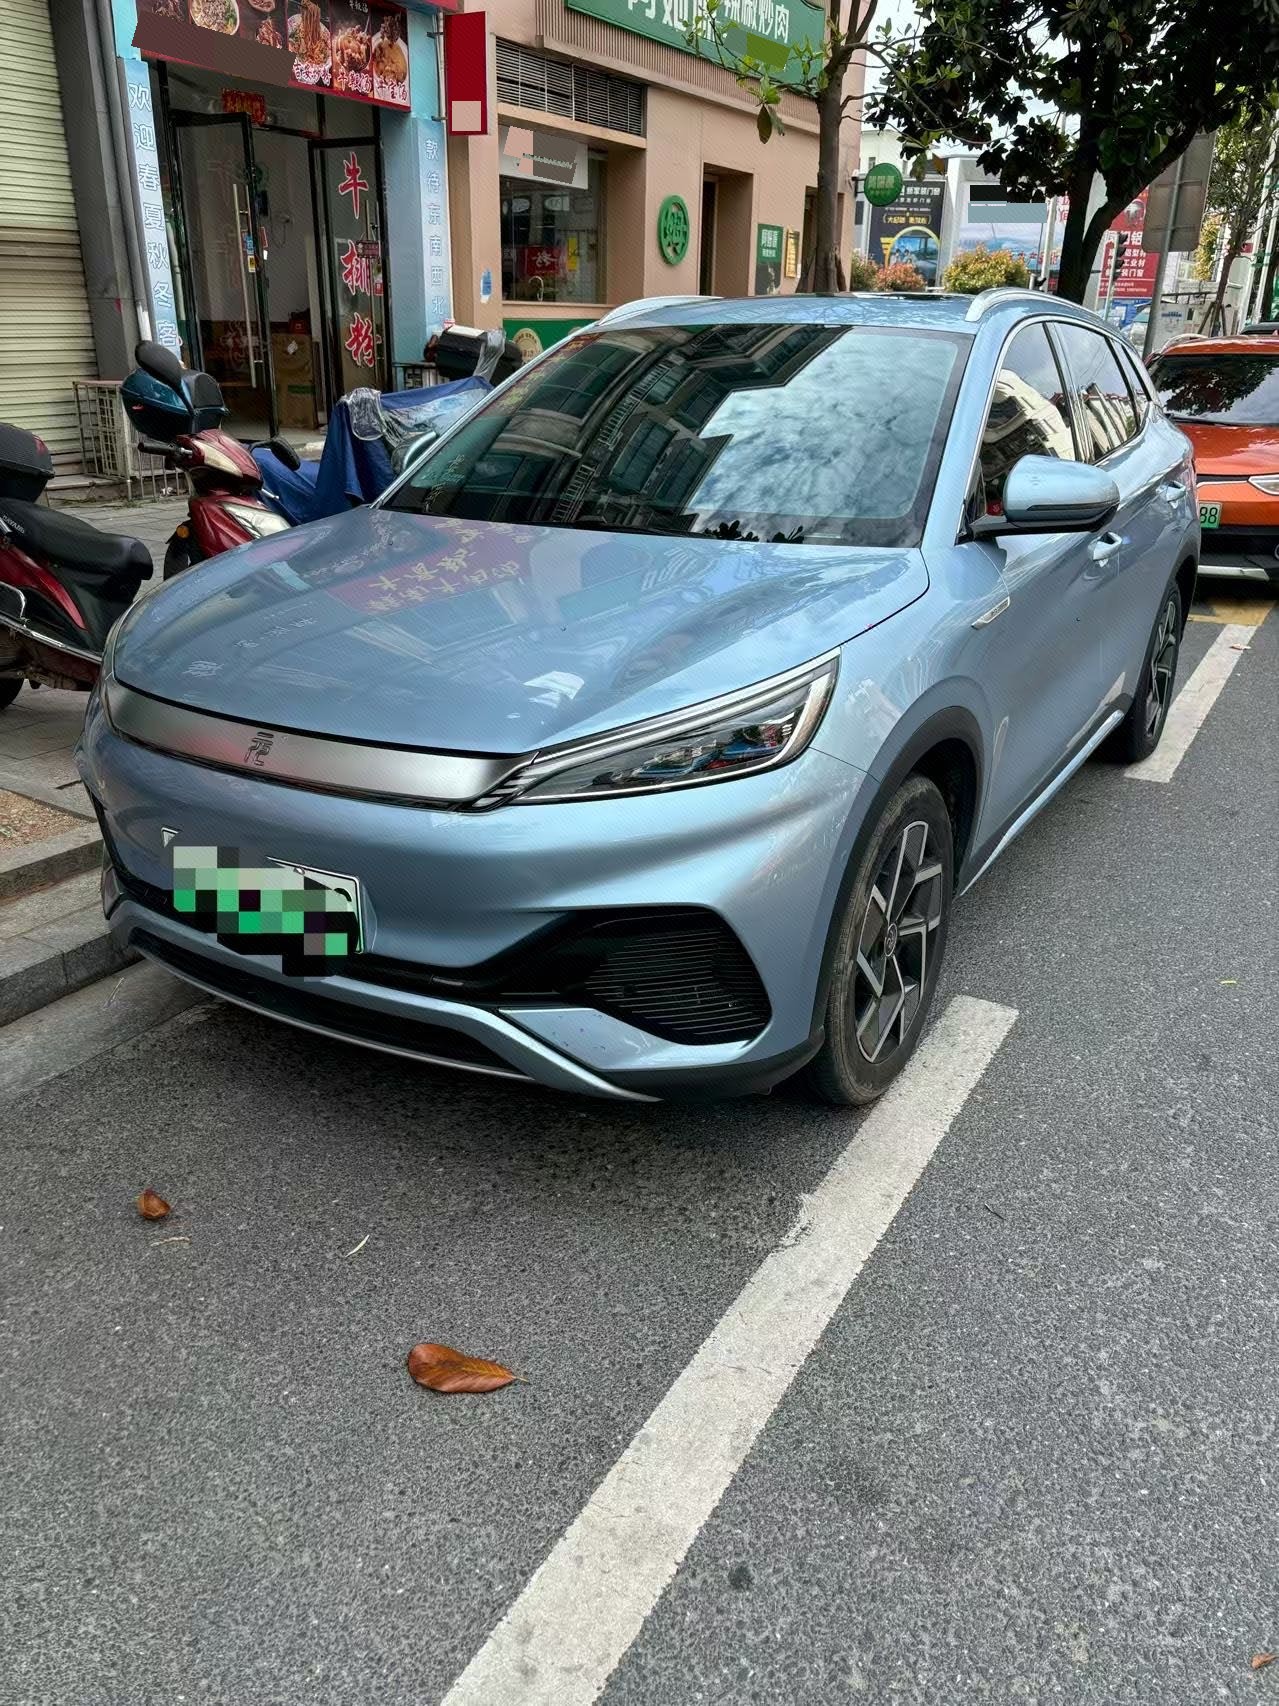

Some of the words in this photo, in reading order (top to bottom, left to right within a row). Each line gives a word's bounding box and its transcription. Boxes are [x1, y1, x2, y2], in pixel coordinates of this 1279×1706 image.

[128, 83, 177, 347] 欢迎春夏秋冬客
[339, 151, 375, 367] 牛排粉
